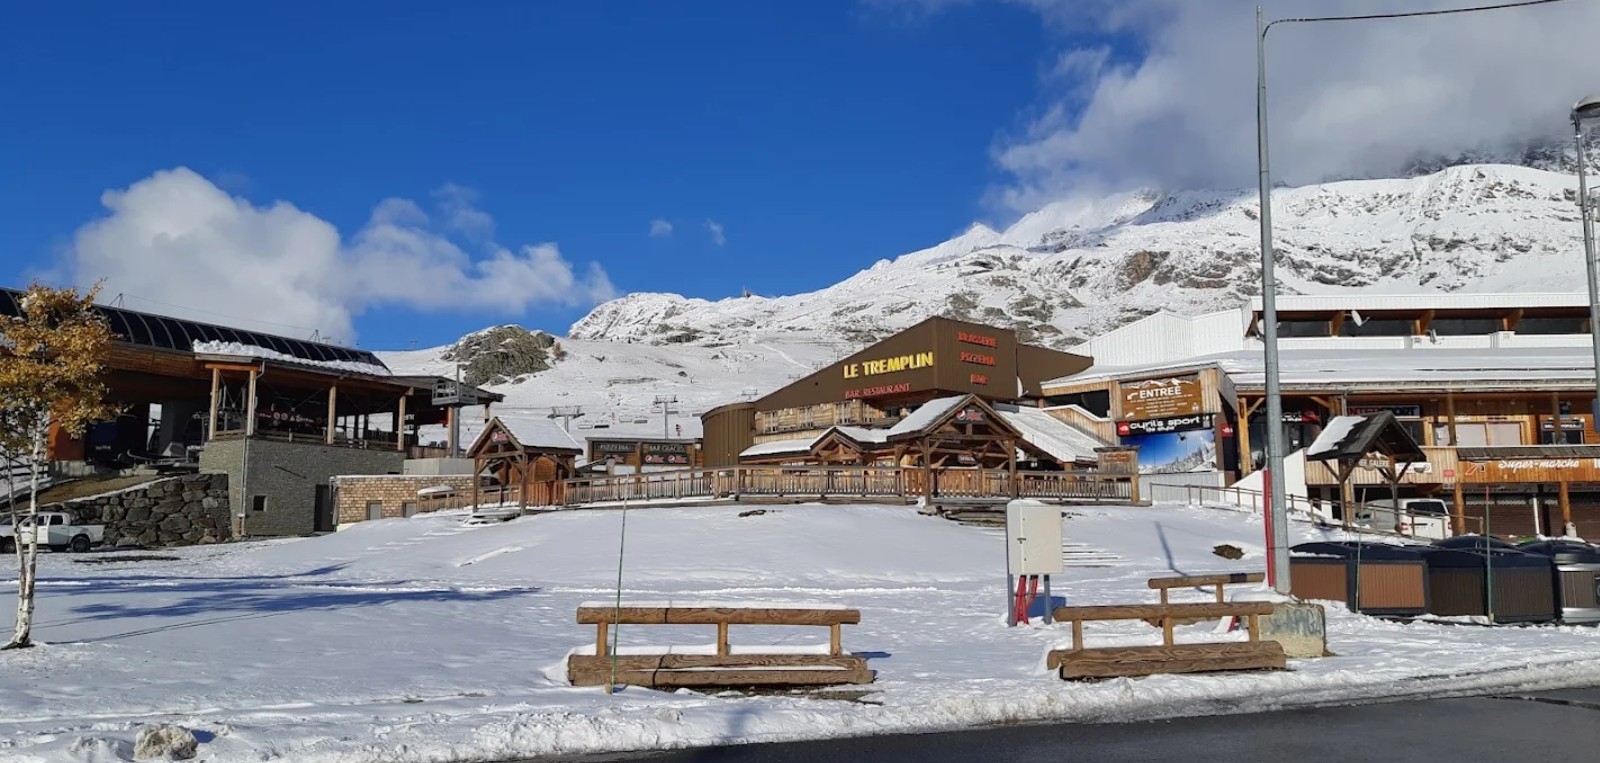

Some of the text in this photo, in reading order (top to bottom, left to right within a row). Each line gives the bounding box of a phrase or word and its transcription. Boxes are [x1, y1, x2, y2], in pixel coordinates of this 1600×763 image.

[958, 332, 997, 346] BRASSERIE
[843, 351, 934, 378] LE TREMPLIN
[960, 352, 995, 365] PIZZERIA
[845, 383, 911, 399] BAR RESTAURANT
[1167, 416, 1200, 427] sport
